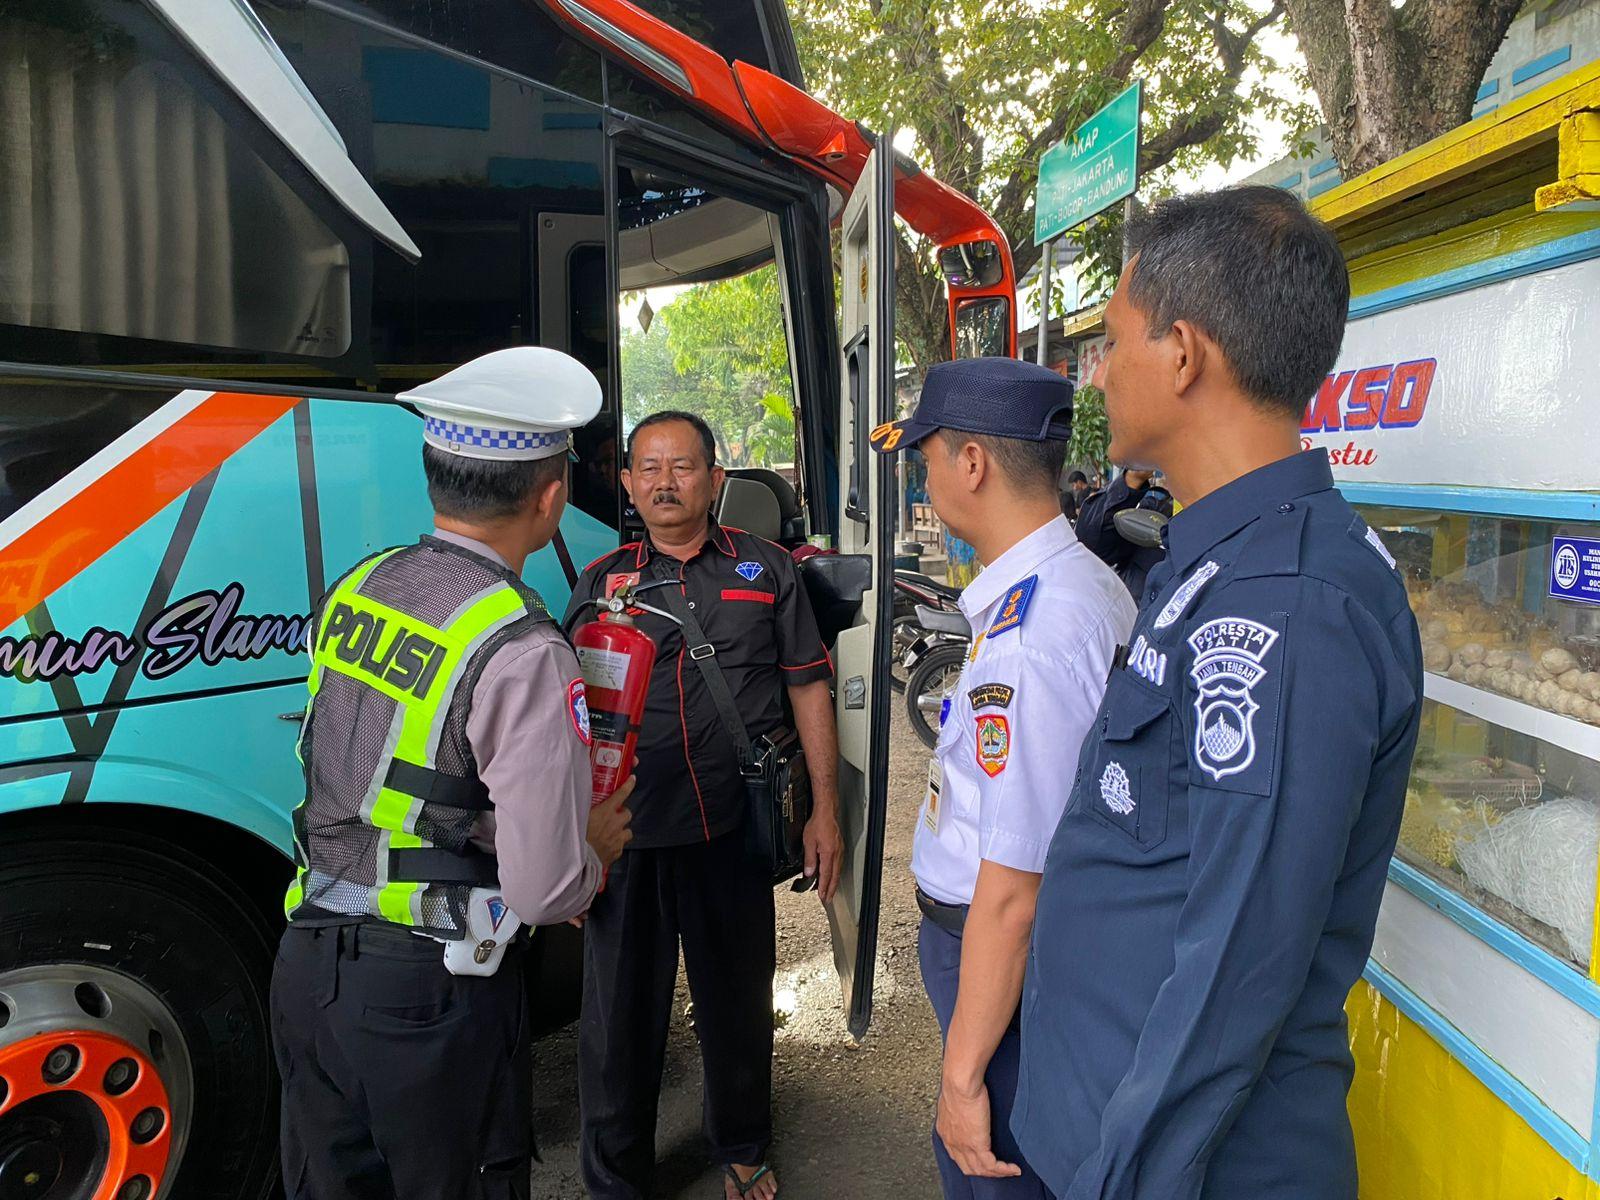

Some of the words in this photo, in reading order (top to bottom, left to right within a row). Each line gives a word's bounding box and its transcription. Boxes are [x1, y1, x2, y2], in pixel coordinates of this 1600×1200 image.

[1070, 127, 1099, 161] AKAP
[1196, 623, 1265, 649] POLRESTA
[1207, 637, 1250, 650] PATI
[319, 602, 448, 701] POLISI
[1221, 661, 1256, 681] TENGAH
